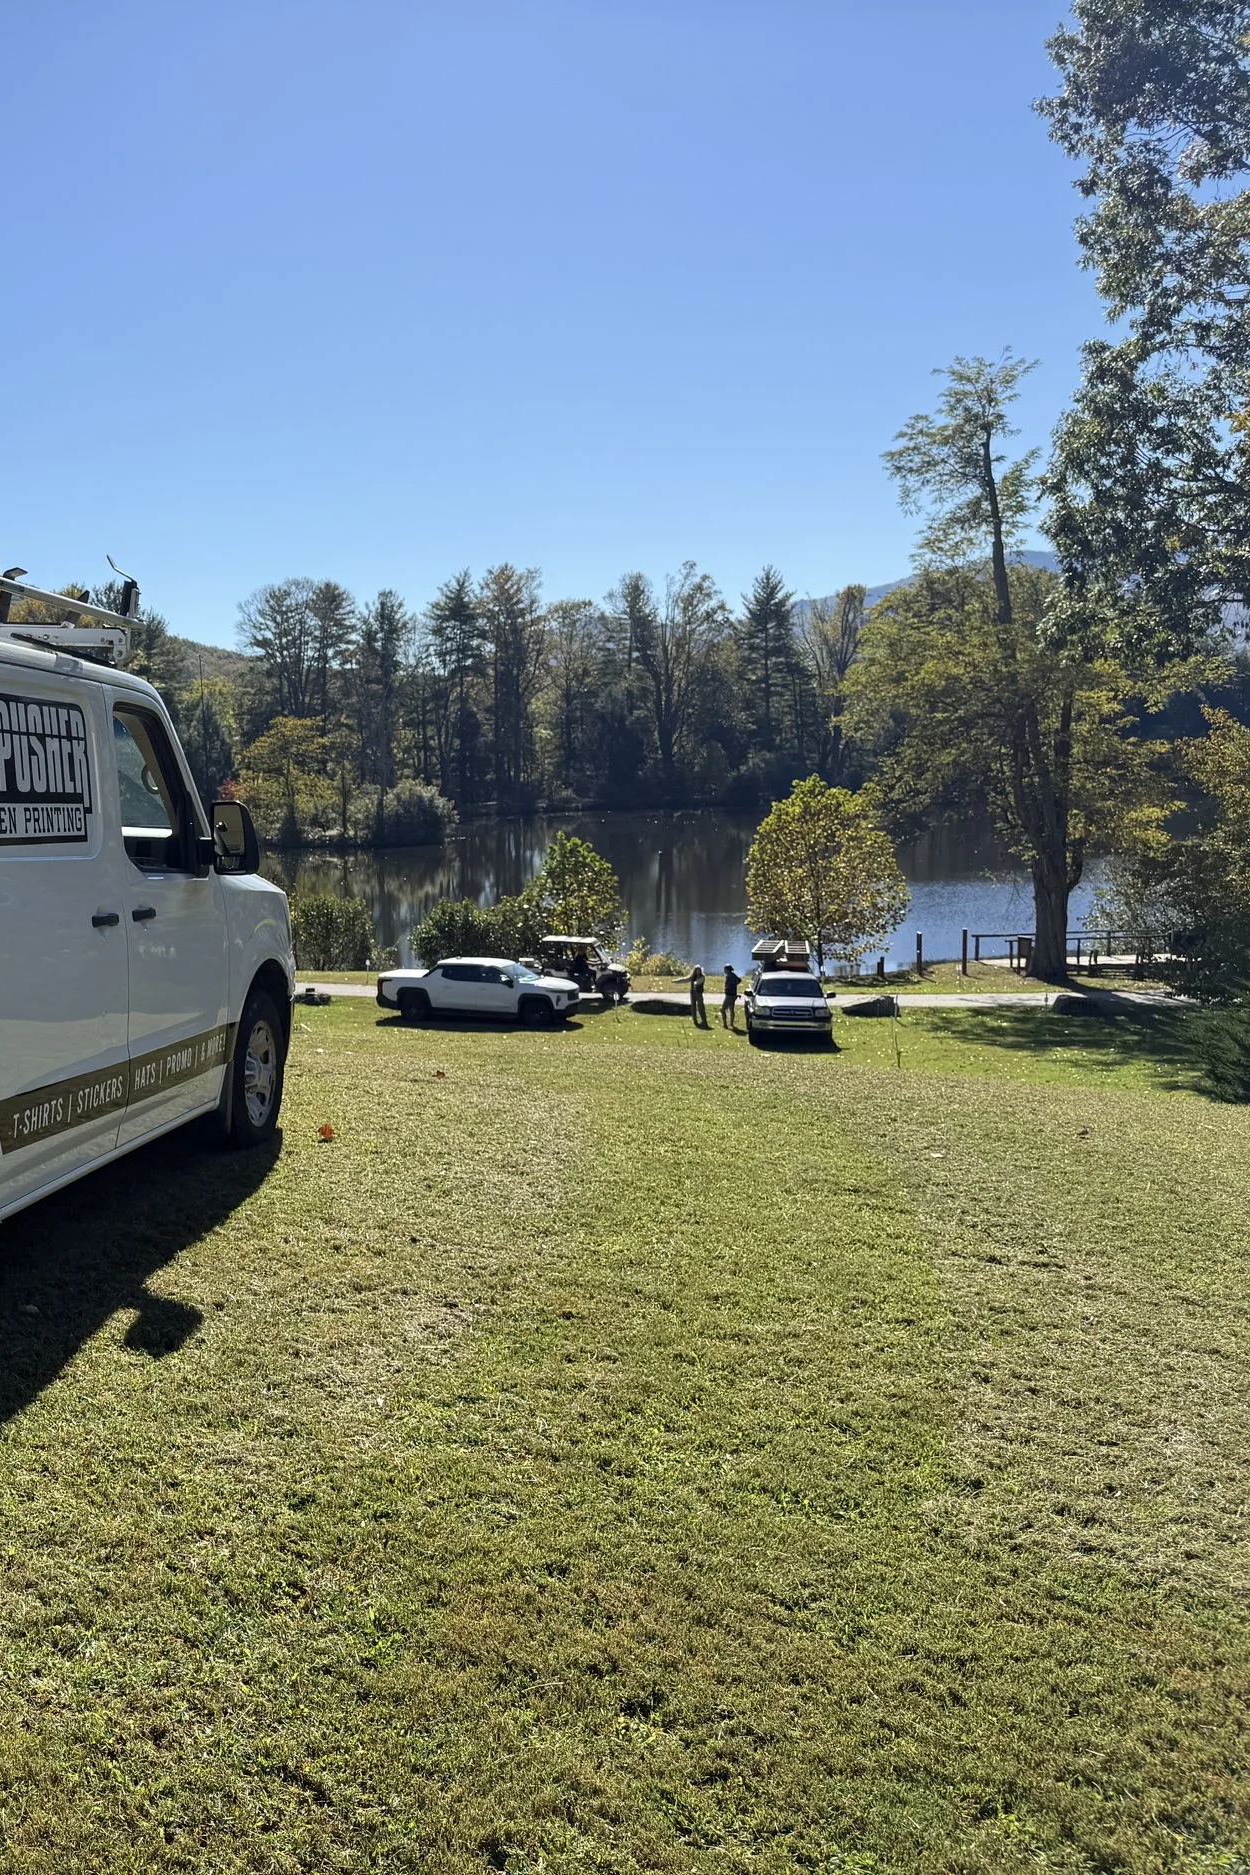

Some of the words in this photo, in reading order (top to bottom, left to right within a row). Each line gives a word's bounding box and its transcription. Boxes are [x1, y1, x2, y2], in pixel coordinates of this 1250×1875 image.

[24, 807, 83, 834] PRINTING
[13, 1099, 63, 1139] T-SHIRTS
[77, 1075, 123, 1114] STICKERS
[134, 1063, 156, 1091] HATS
[166, 1047, 192, 1077] PROMO
